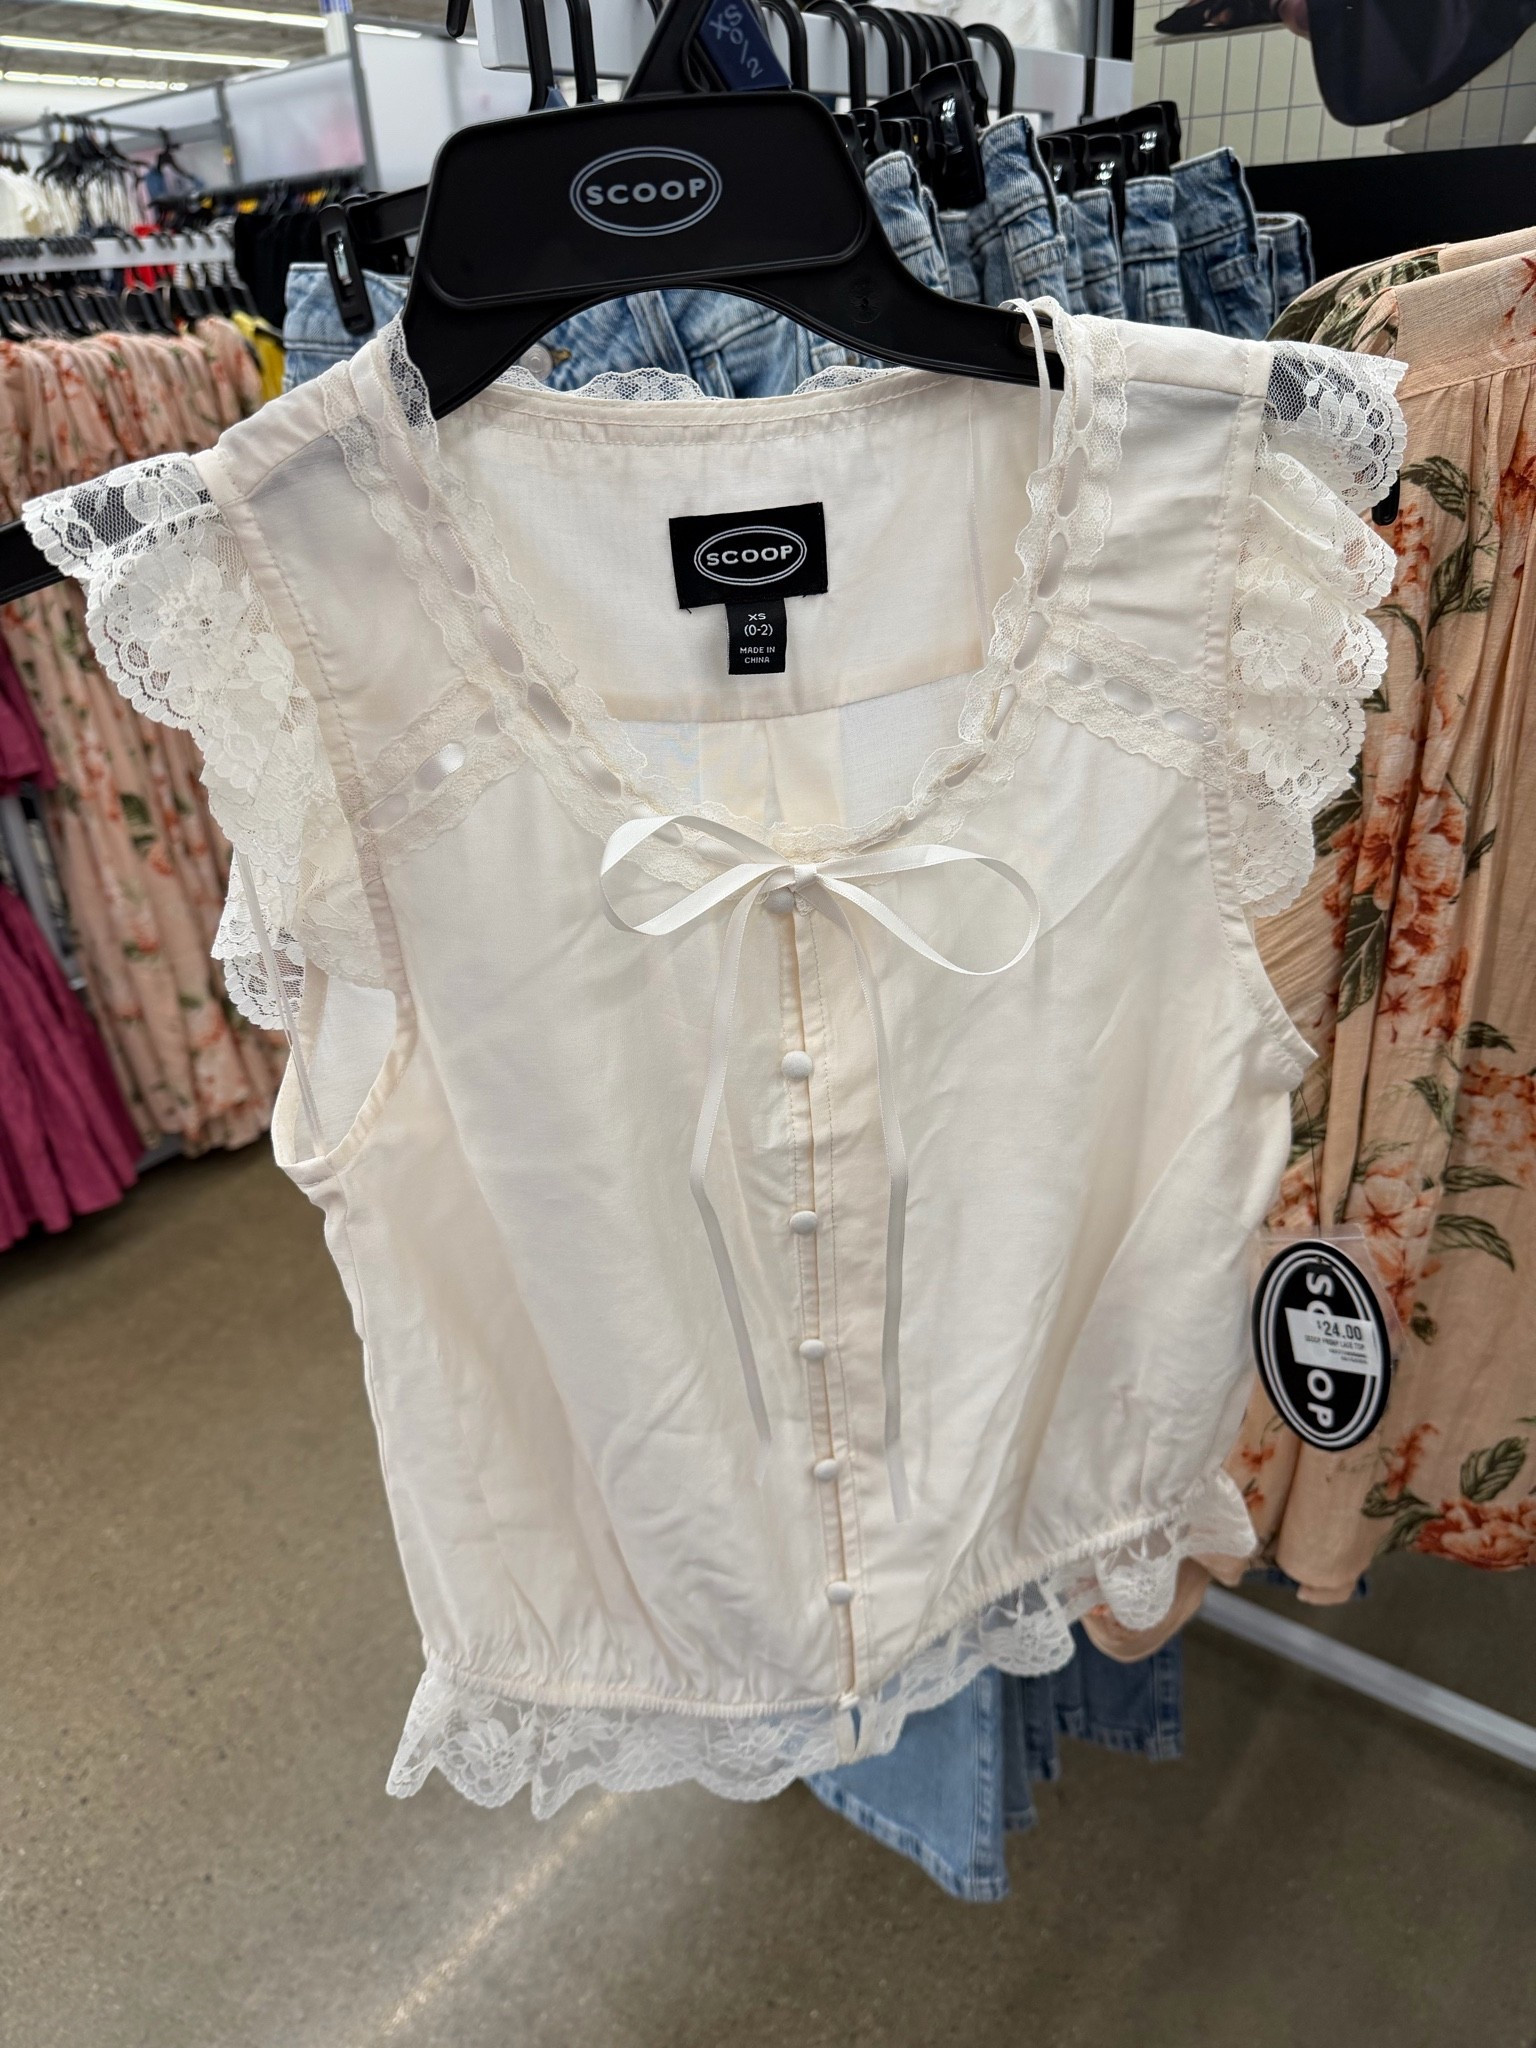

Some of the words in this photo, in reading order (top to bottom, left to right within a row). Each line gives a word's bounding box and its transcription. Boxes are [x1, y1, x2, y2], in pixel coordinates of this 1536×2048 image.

[709, 4, 743, 40] XS
[585, 178, 707, 206] SCOOP
[706, 545, 794, 566] SCOOP
[748, 612, 767, 621] XS
[744, 623, 774, 637] (0-2)
[740, 646, 765, 654] MADE
[744, 656, 770, 664] CHINA
